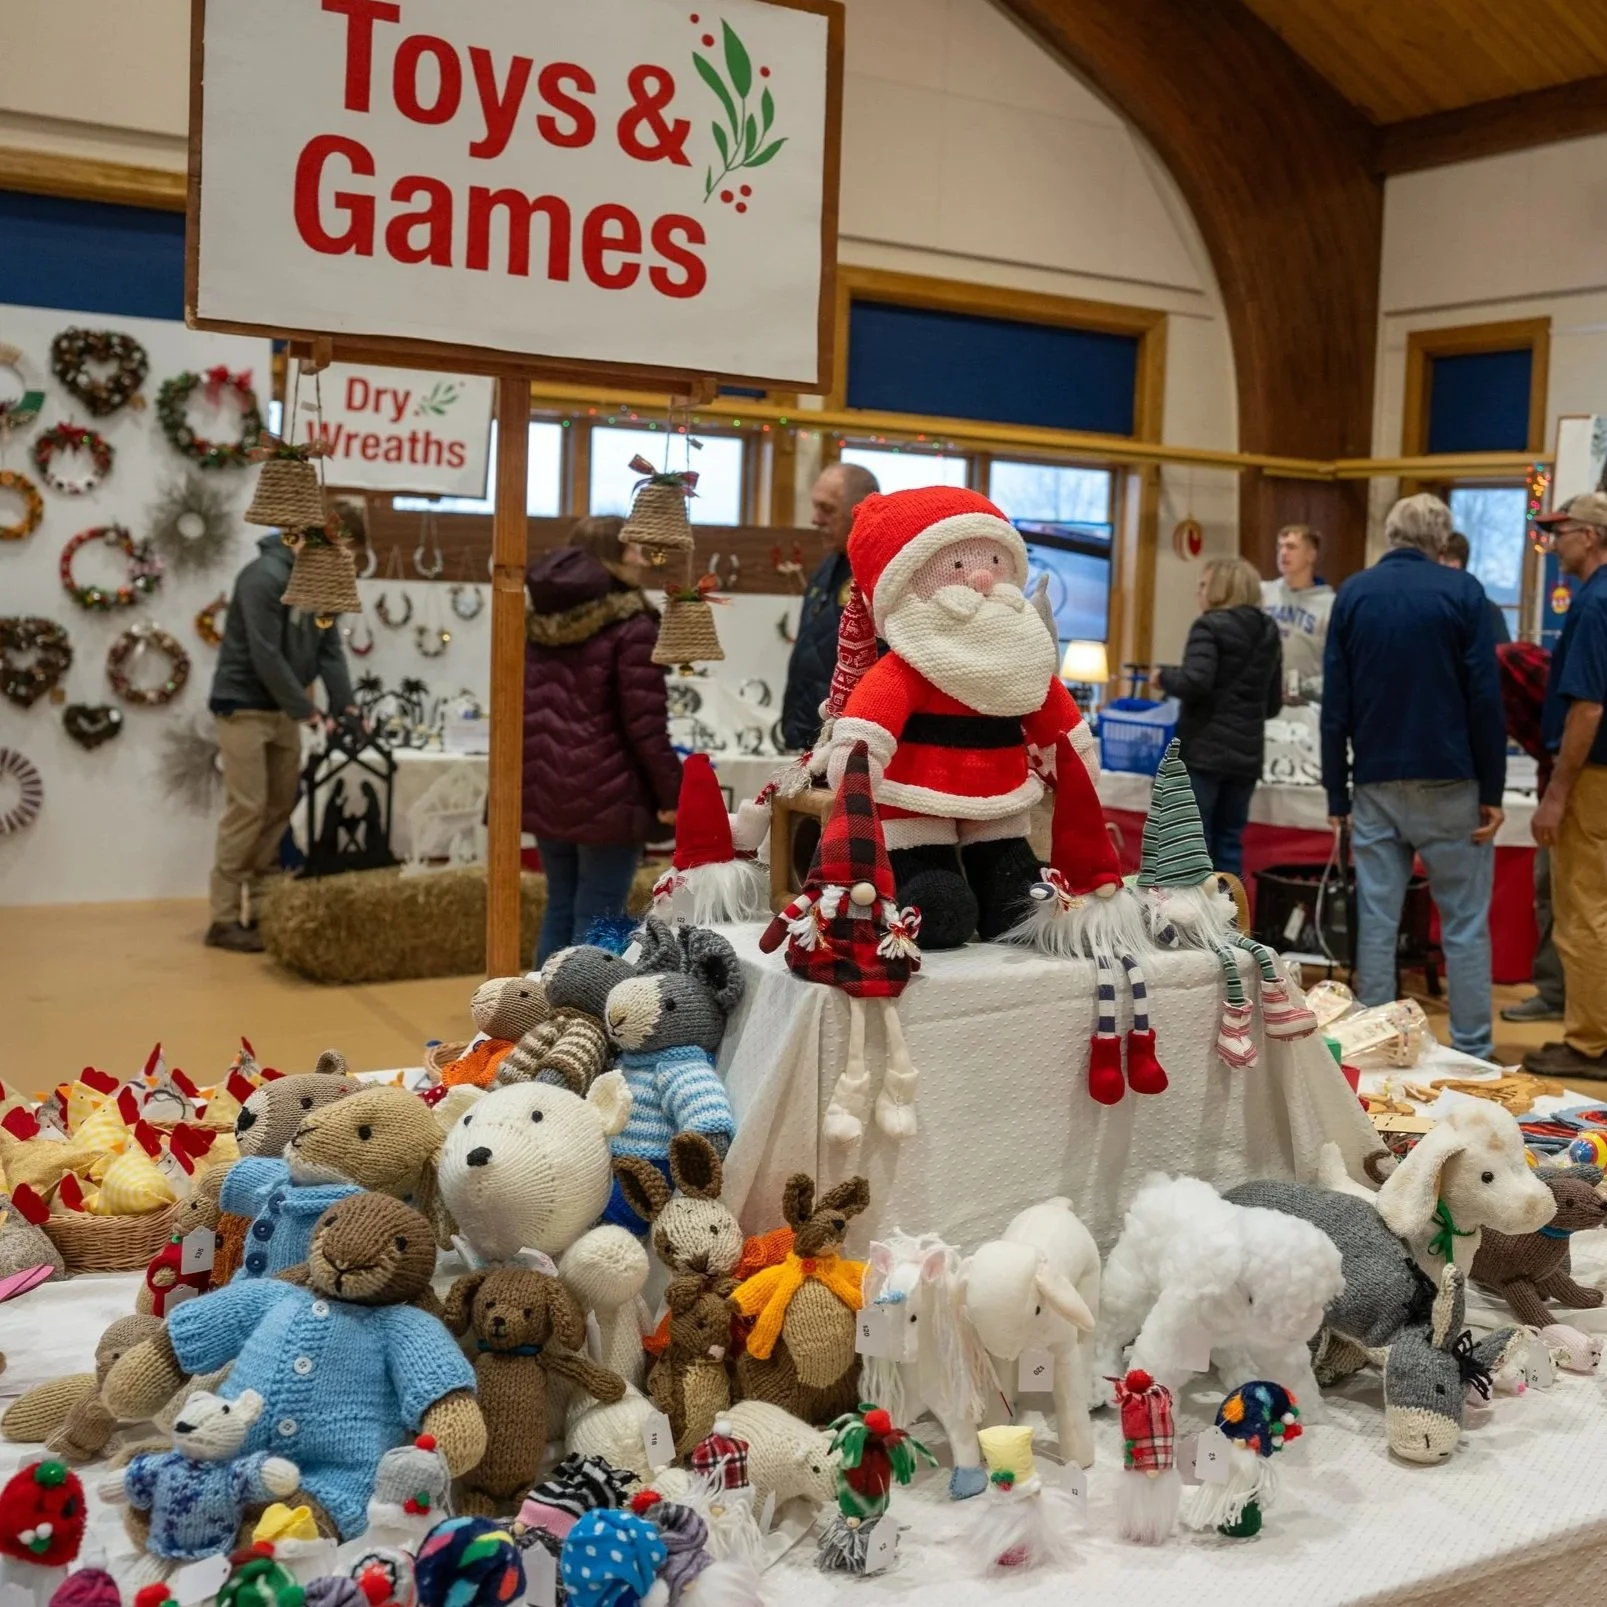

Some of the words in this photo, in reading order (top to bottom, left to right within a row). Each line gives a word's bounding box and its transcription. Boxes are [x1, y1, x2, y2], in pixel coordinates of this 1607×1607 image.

[321, 0, 597, 159] Toys
[617, 64, 692, 167] &
[293, 134, 708, 299] Games
[306, 420, 467, 469] Wreaths
[344, 375, 412, 423] Dry
